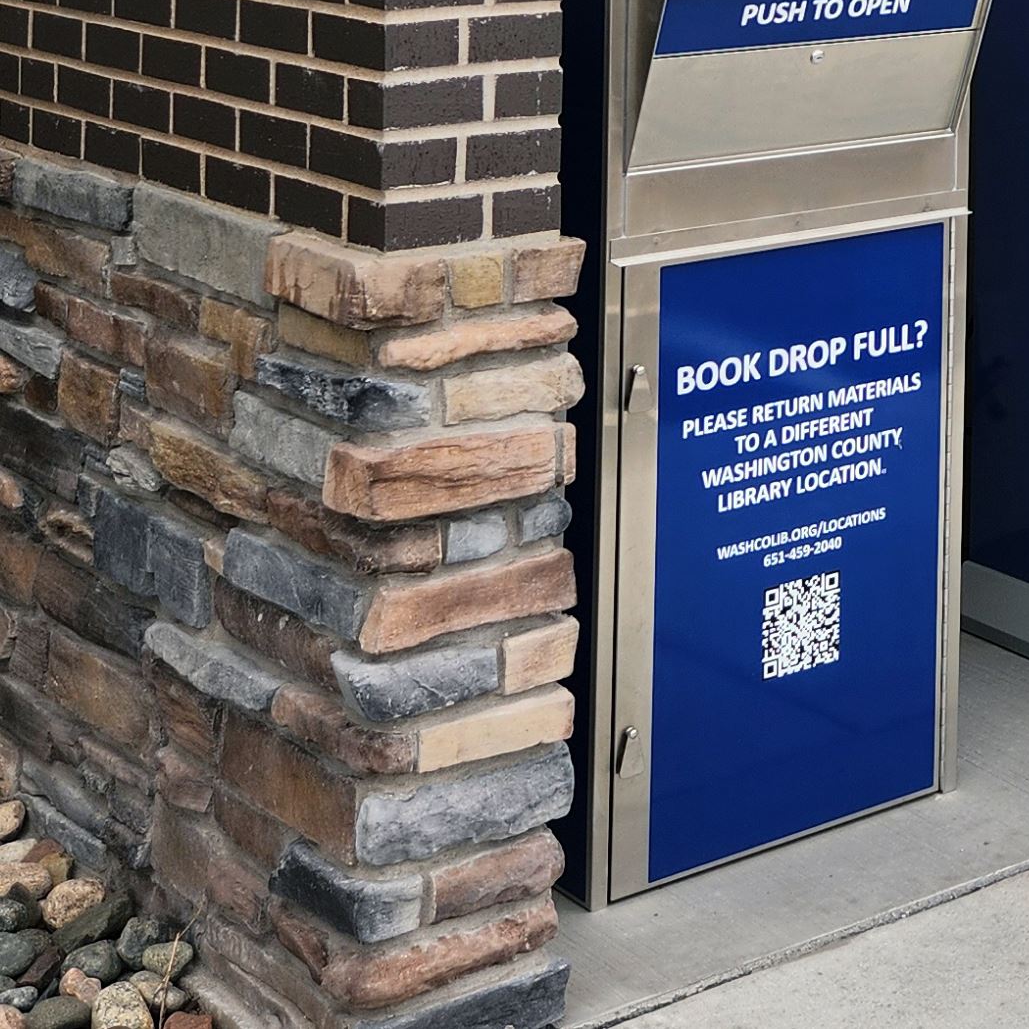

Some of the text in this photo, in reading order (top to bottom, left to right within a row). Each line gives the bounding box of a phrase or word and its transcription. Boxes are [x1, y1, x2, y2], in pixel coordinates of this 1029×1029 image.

[740, 0, 806, 26] PUSH
[677, 320, 929, 396] BOOK DROP FULL?
[683, 372, 922, 439] PLEASE RETURN MATERIALS
[735, 408, 874, 454] TO A DIFFERENT
[702, 427, 903, 489] WASHINGTON COUNTY
[718, 457, 887, 513] LIBRARY LOCATION.
[717, 507, 886, 561] WASHCOLIB.ORG/LOCATIONS
[763, 536, 843, 568] 651-459-2040
